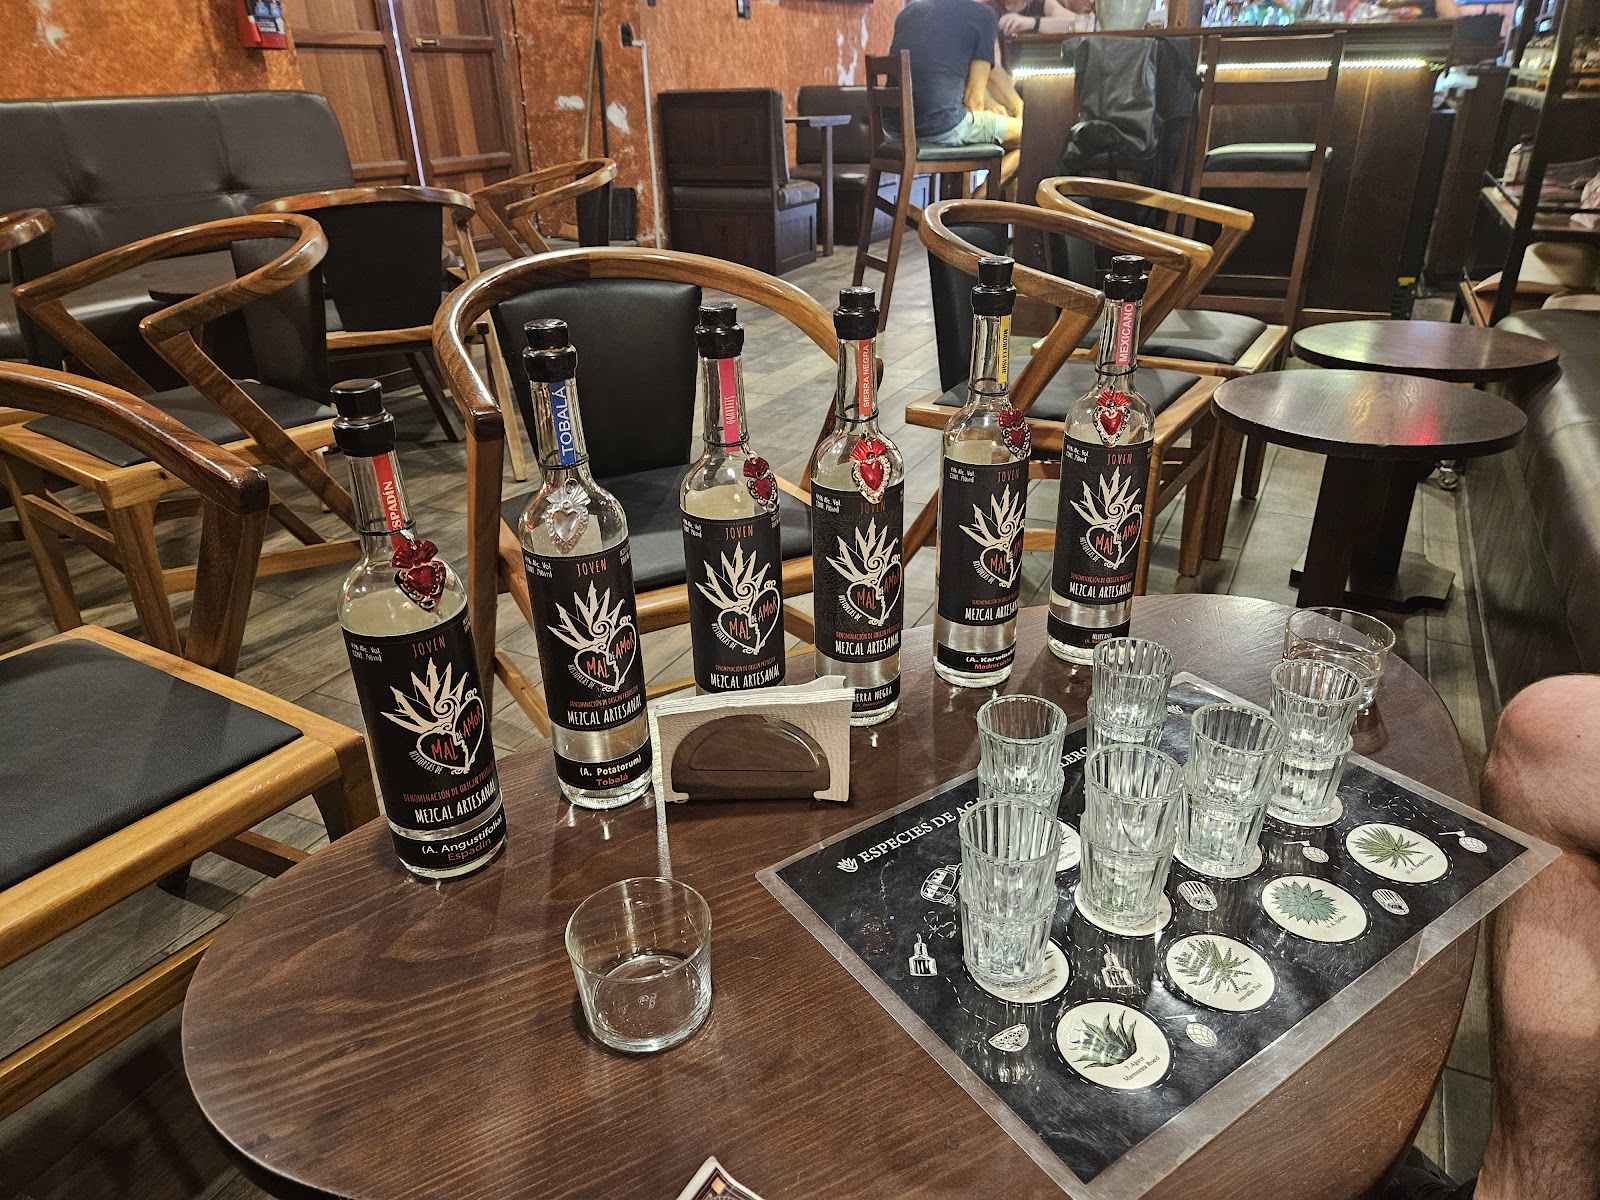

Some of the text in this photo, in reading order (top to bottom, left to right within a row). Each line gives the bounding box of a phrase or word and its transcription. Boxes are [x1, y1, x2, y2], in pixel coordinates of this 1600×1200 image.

[1119, 303, 1134, 362] MEXICANO
[552, 385, 574, 457] TOBALÁ
[1107, 453, 1132, 465] JOVEN
[997, 468, 1020, 483] JOVEN
[860, 501, 885, 515] JOVEN
[725, 526, 754, 541] JOVEN
[1096, 533, 1114, 556] MAL
[576, 558, 607, 577] JOVEN
[990, 554, 1007, 574] MAL
[857, 588, 876, 610] MAL
[1070, 582, 1096, 598] MEZCAL
[758, 596, 778, 622] AMOR
[965, 600, 1018, 620] MEZCAL ARTESA
[729, 618, 751, 640] MAL
[412, 635, 446, 658] JOVEN
[615, 632, 634, 660] AMOR
[835, 640, 864, 656] MEZCAL
[586, 656, 610, 678] MAL
[710, 663, 780, 688] MEZCAL ARTESANAL
[856, 686, 892, 702] ERRA NEGRA
[463, 705, 482, 738] AMOR
[568, 710, 600, 725] MEZCAL
[431, 738, 458, 760] MAL
[580, 754, 642, 777] (A. Potatorum)
[596, 773, 628, 786] Tobalá
[415, 805, 454, 823] MEZCAL
[422, 814, 502, 854] (A. Angustifolia)
[858, 821, 933, 863] ESPECIES
[930, 810, 956, 833] DE
[448, 838, 492, 861] Espadín
